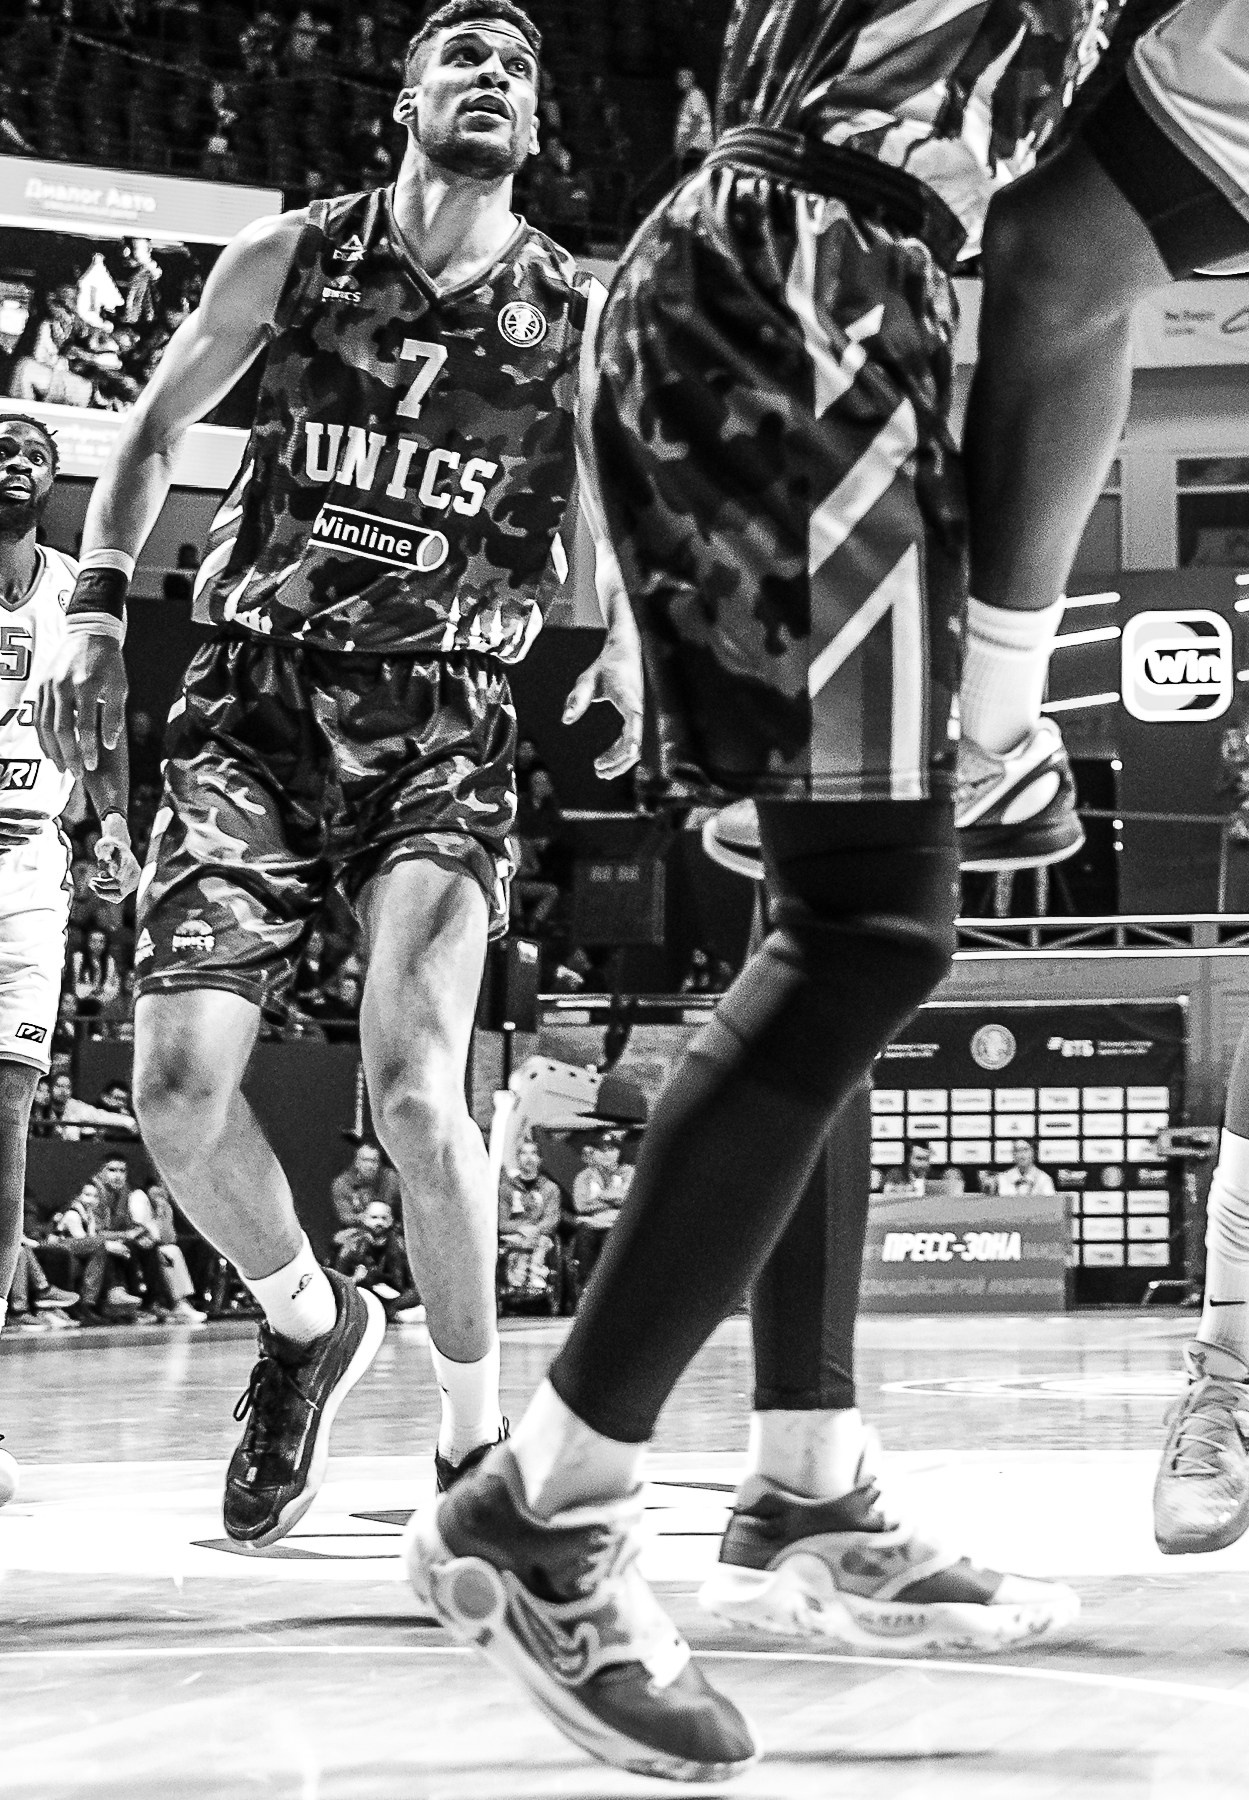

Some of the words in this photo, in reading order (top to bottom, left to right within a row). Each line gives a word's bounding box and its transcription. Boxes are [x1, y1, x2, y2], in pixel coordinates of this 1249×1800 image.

[25, 177, 103, 206] Диалог
[105, 187, 157, 213] Авто
[396, 338, 449, 420] 7
[304, 421, 499, 517] UNICS
[312, 515, 413, 558] Winline
[0, 760, 40, 790] RI
[881, 1231, 1022, 1263] ПРЕСС-ЗОНА
